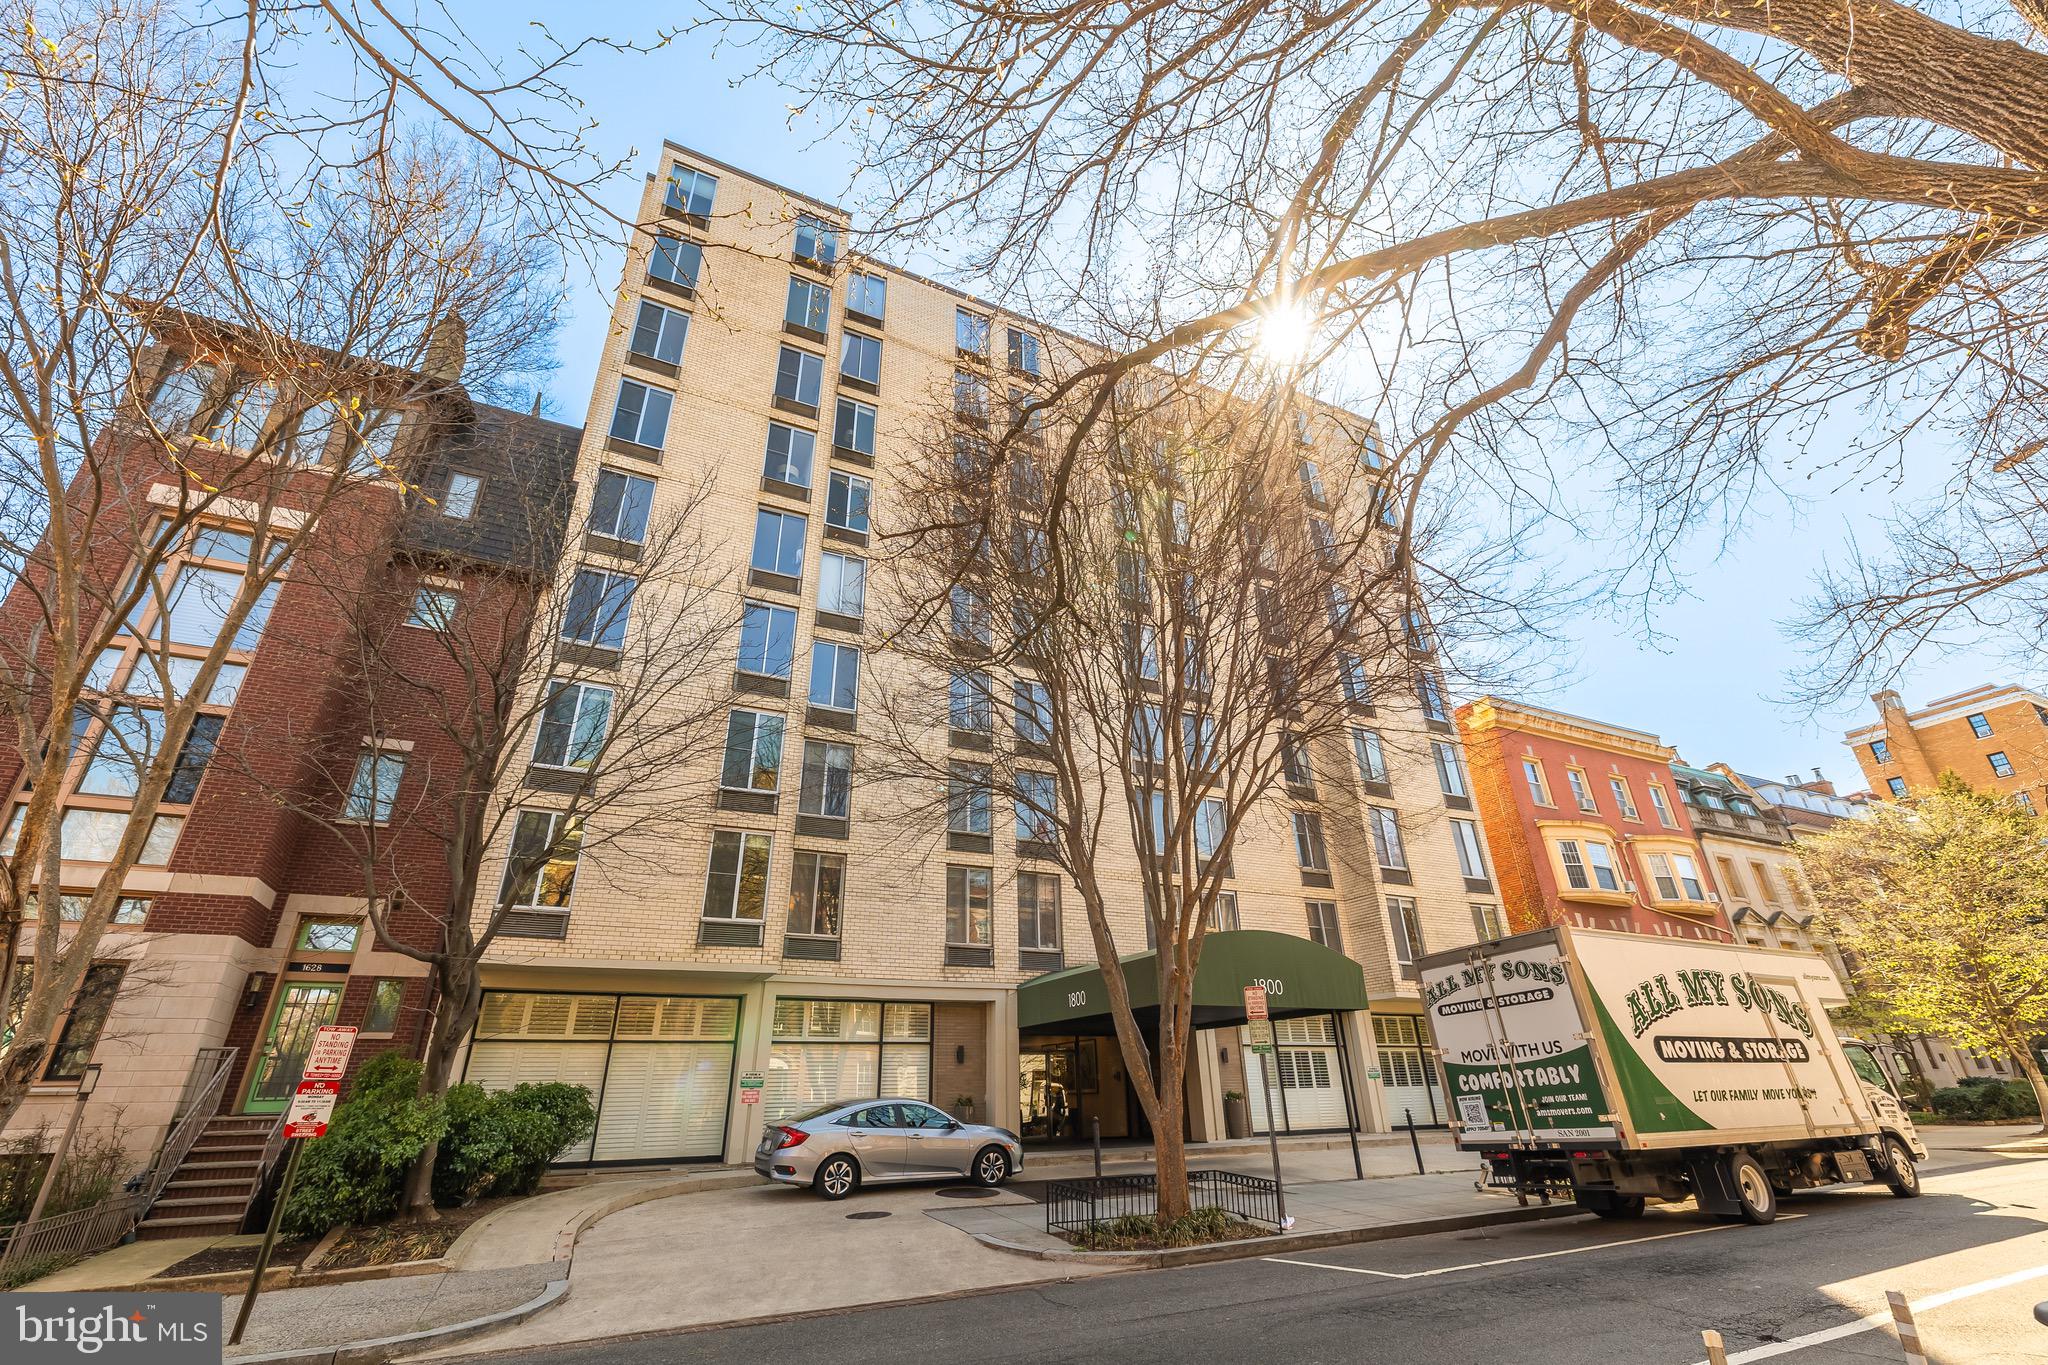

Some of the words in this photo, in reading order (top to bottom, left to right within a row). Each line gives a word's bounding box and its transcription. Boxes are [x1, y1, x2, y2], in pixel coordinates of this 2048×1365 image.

[302, 964, 322, 972] 1628
[1426, 975, 1460, 1009] ALL
[1461, 963, 1496, 988] MY
[1501, 960, 1566, 986] SONS
[1068, 990, 1086, 1008] 1800
[1442, 999, 1484, 1016] MOVING
[1487, 998, 1496, 1008] &
[1499, 989, 1551, 1007] STORAGE
[1625, 974, 1683, 1039] ALL
[1676, 969, 1728, 1007] MY
[1730, 973, 1814, 1040] SONS
[318, 1041, 349, 1049] STANDING
[322, 1049, 347, 1057] PARKING
[1500, 1043, 1540, 1059] WITH
[1542, 1040, 1563, 1055] US
[1659, 1040, 1725, 1060] MOVING
[1729, 1041, 1743, 1060] &
[1745, 1042, 1806, 1060] STORAGE
[1458, 1063, 1580, 1092] COMFORTABLY
[1541, 1095, 1555, 1103] JOIN
[1555, 1094, 1567, 1102] OUR
[1693, 1090, 1708, 1102] LET
[1710, 1090, 1728, 1101] OUR
[1729, 1089, 1758, 1101] FAMILY
[1762, 1089, 1785, 1100] MOVE
[1557, 1129, 1574, 1138] SAN
